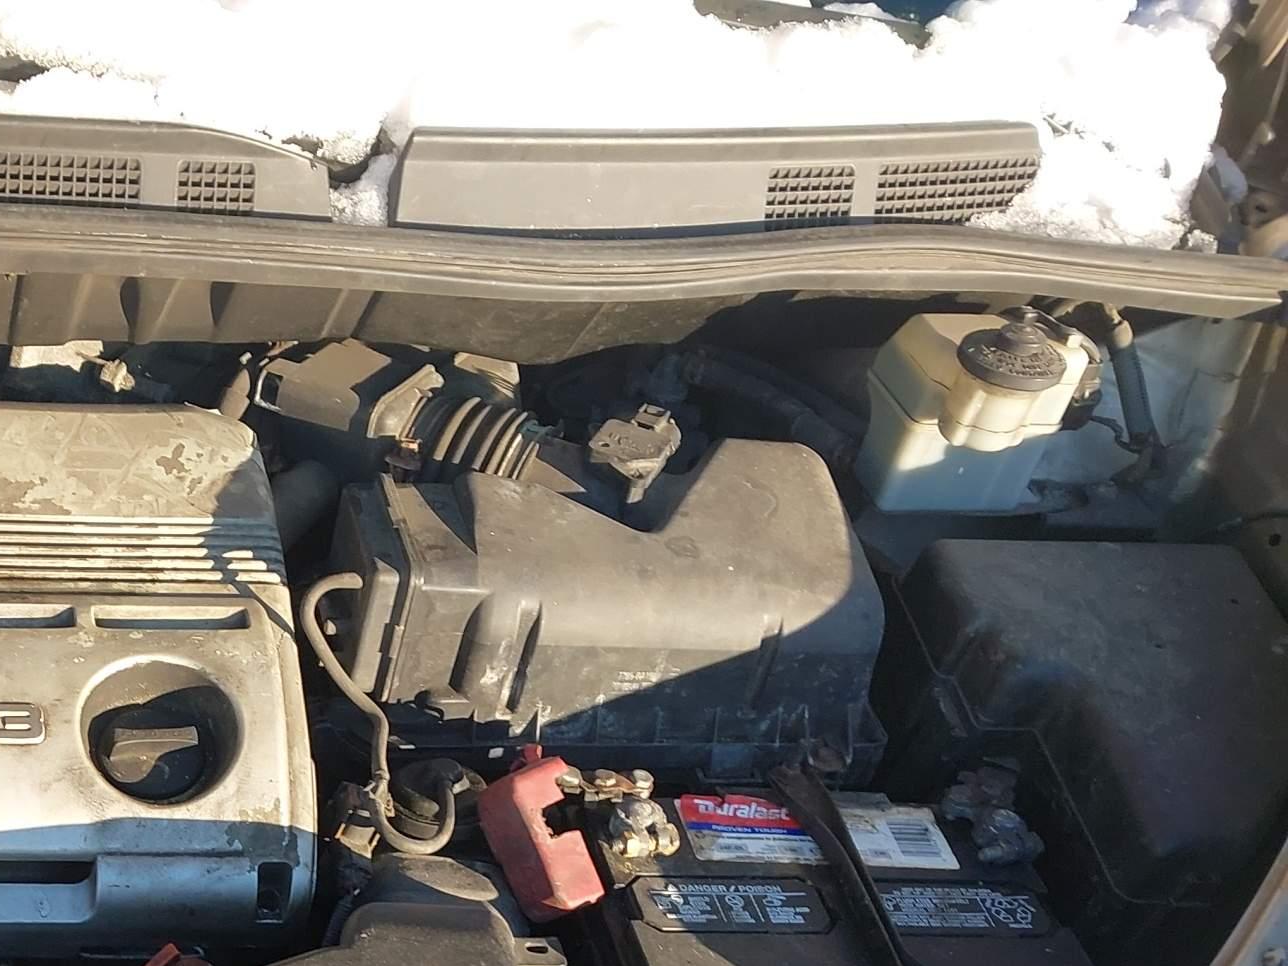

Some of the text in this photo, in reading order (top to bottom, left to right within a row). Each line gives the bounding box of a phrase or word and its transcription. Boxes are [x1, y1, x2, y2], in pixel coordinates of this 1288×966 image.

[693, 799, 791, 822] Duralast
[679, 884, 728, 893] DANGER
[738, 884, 782, 893] POISON
